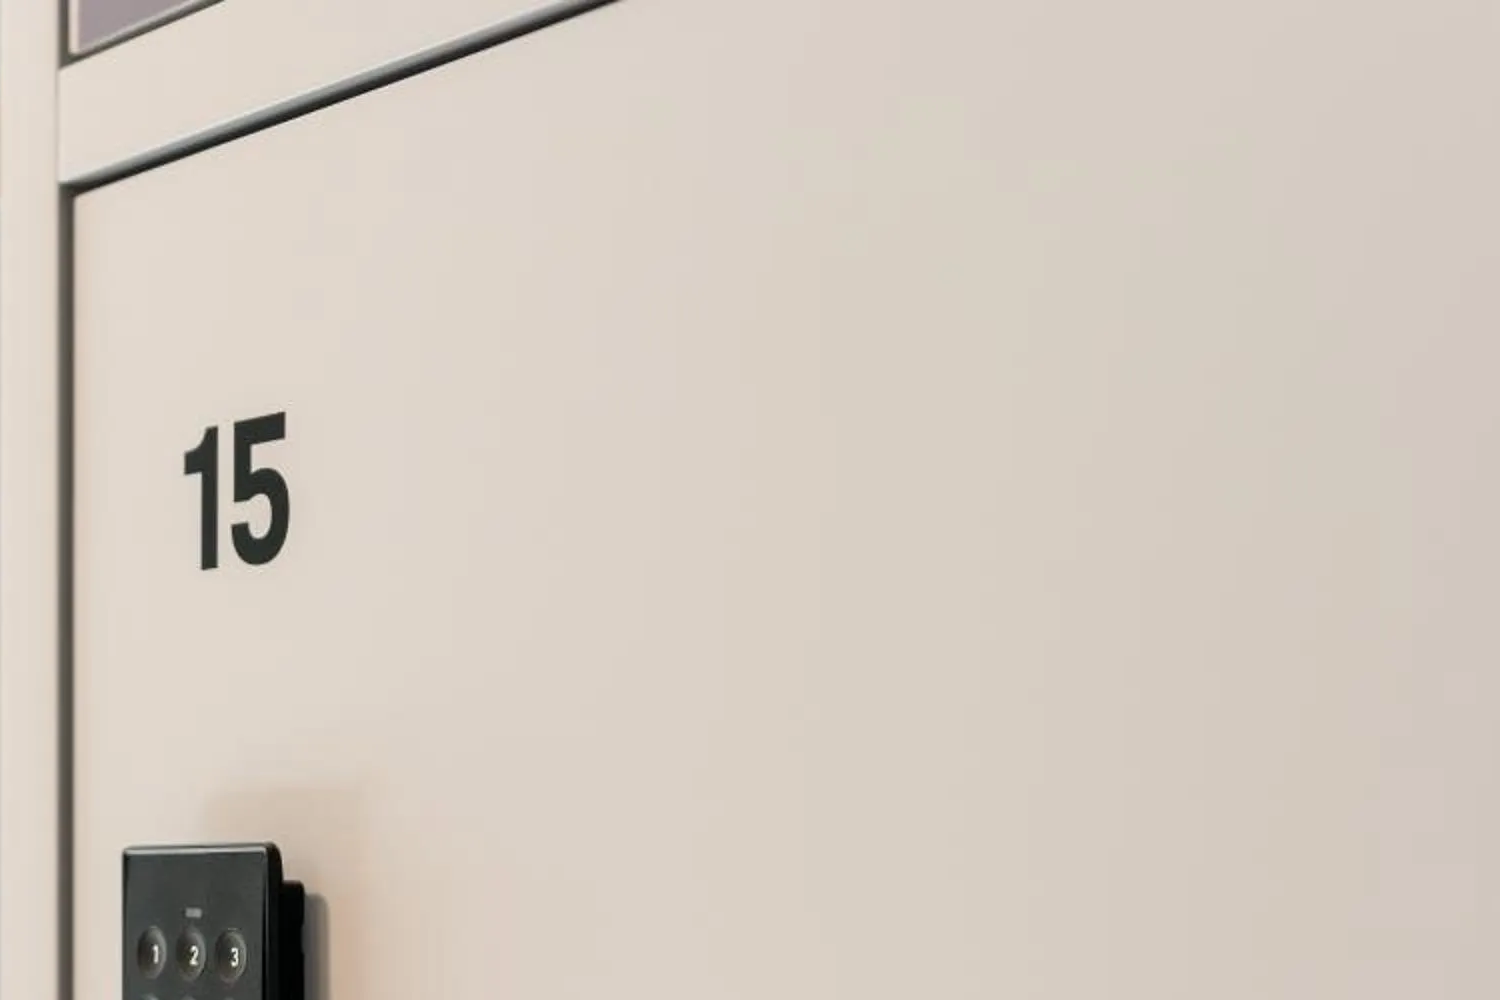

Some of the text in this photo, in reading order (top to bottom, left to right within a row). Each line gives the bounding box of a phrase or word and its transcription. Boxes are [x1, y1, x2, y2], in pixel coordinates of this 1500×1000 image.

[184, 411, 290, 571] 15
[152, 944, 240, 967] 1 2 3
